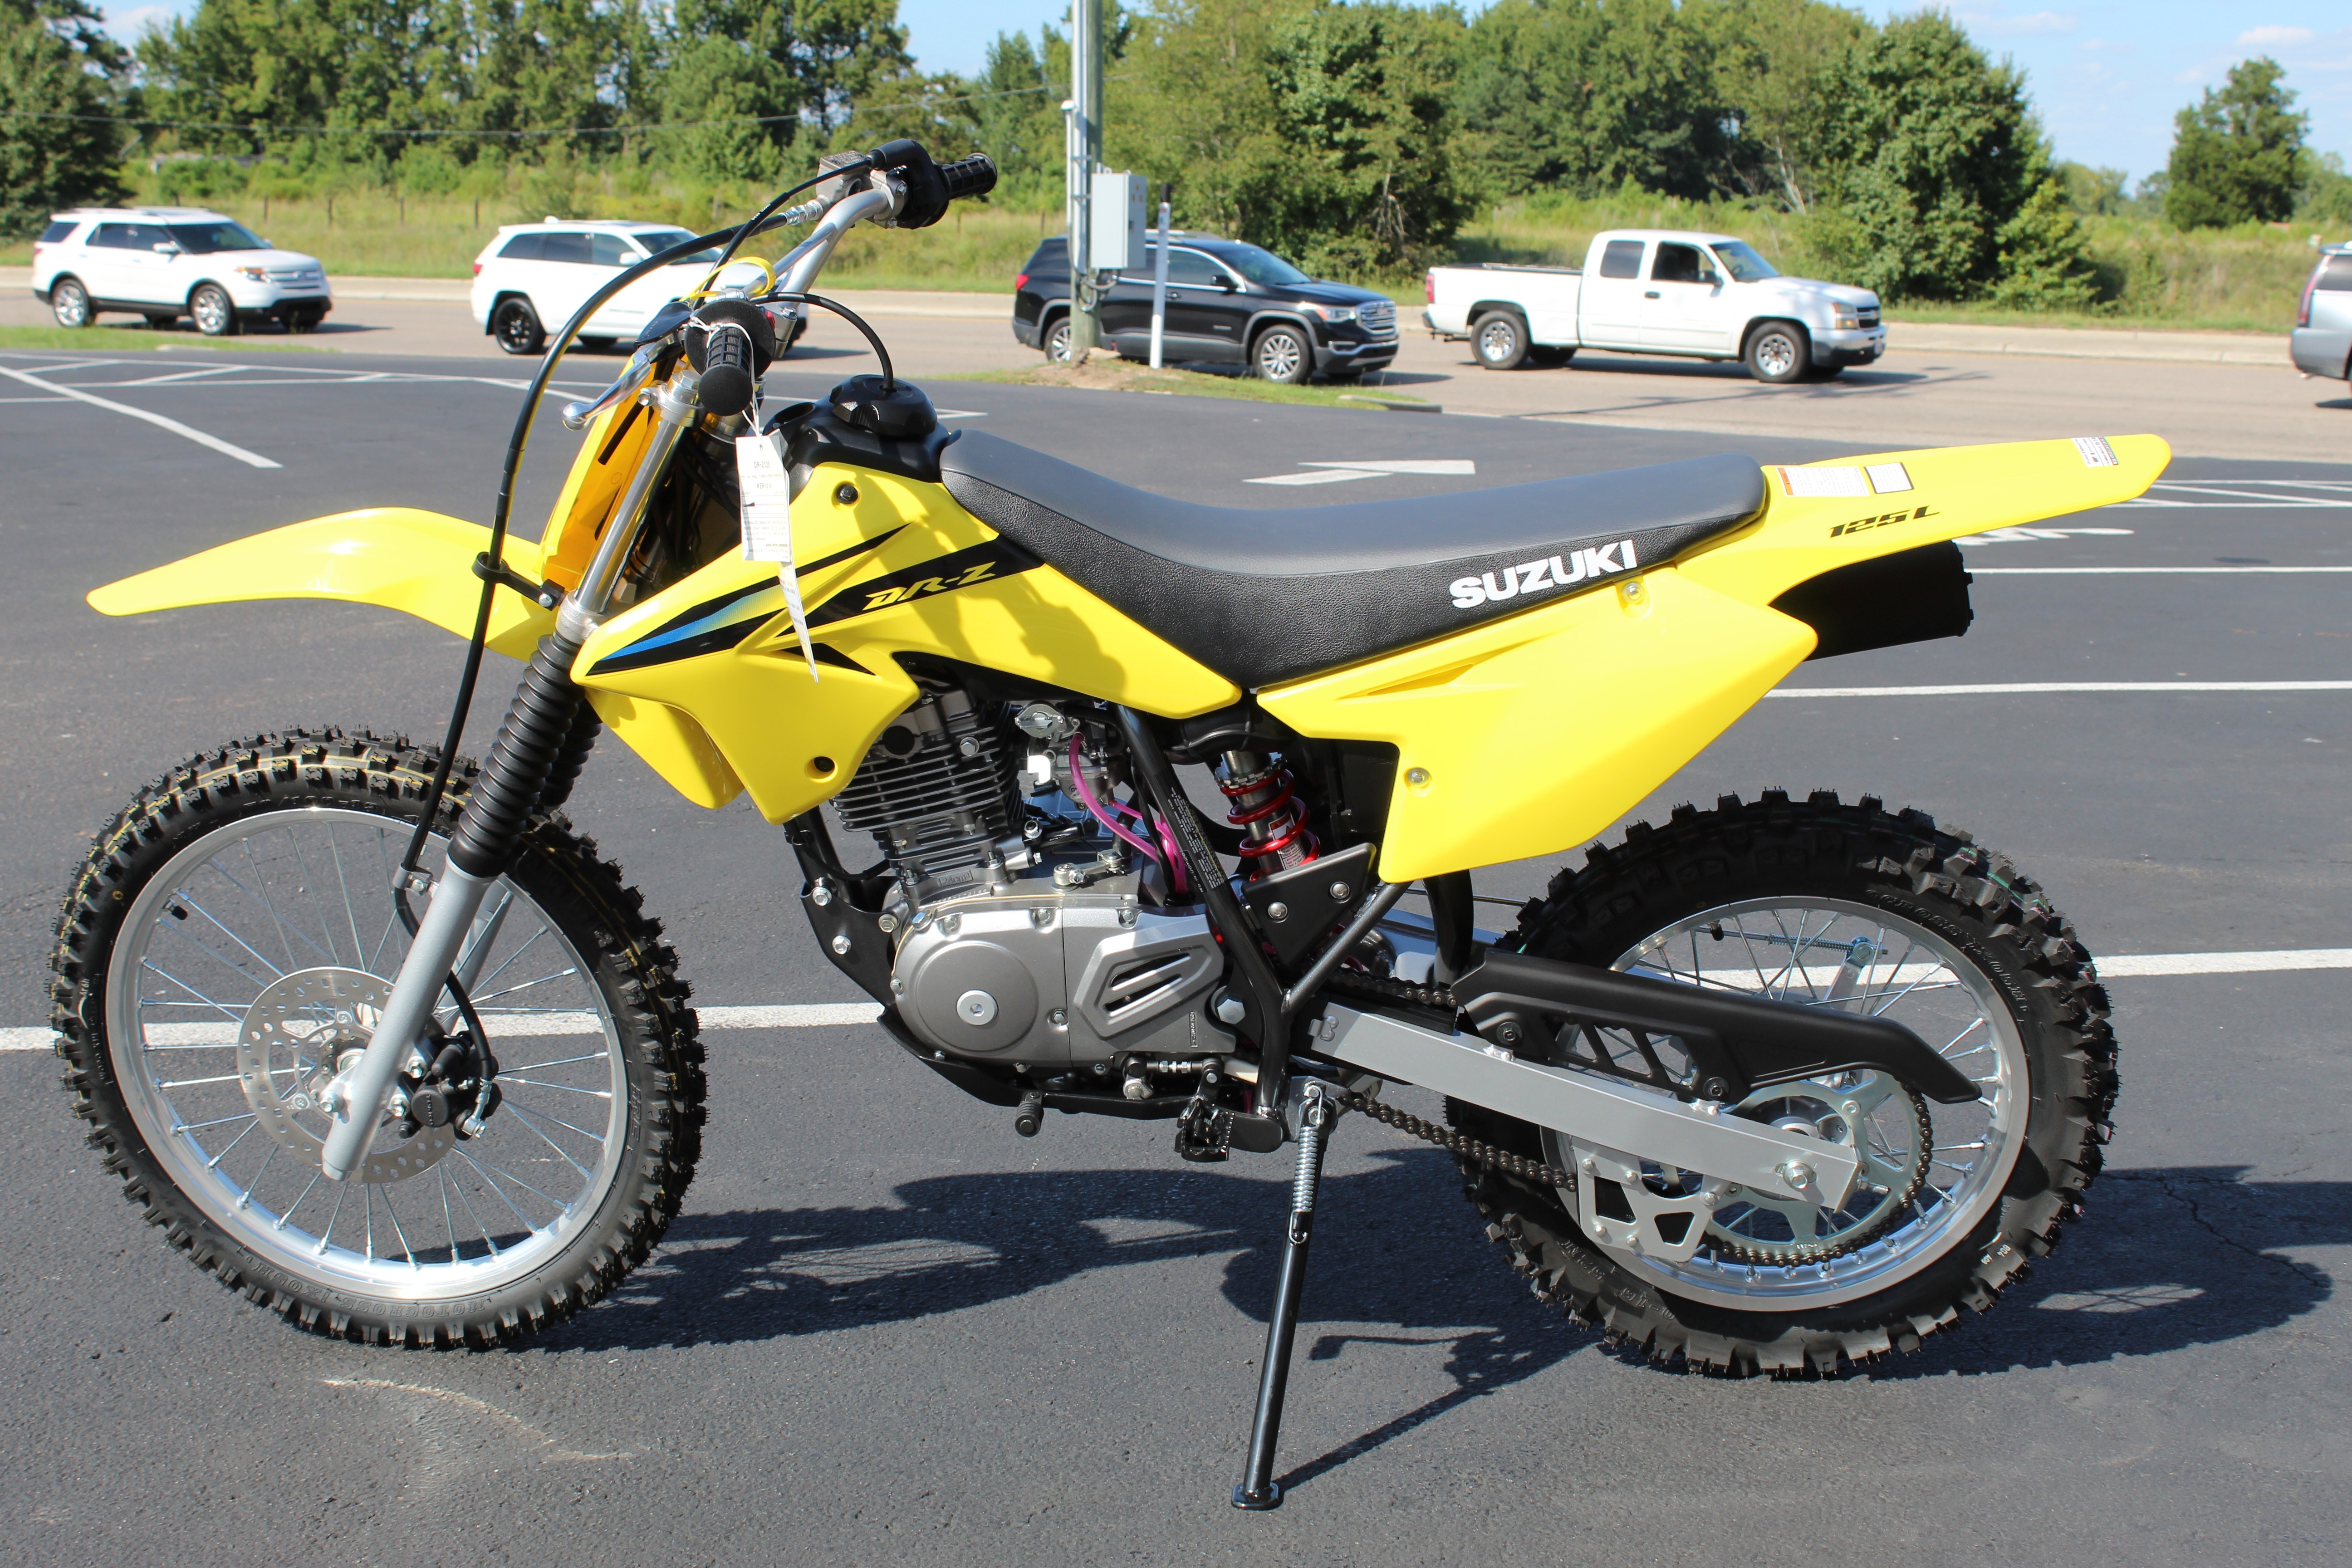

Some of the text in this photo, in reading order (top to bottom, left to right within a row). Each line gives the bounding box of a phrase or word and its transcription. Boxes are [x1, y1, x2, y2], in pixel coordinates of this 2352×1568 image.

[862, 561, 997, 611] DR-Z
[1449, 539, 1638, 609] SUZUKI
[631, 1082, 642, 1143] IRC
[1559, 1239, 1605, 1281] 52M
[338, 1296, 487, 1318] MOTOCROSS
